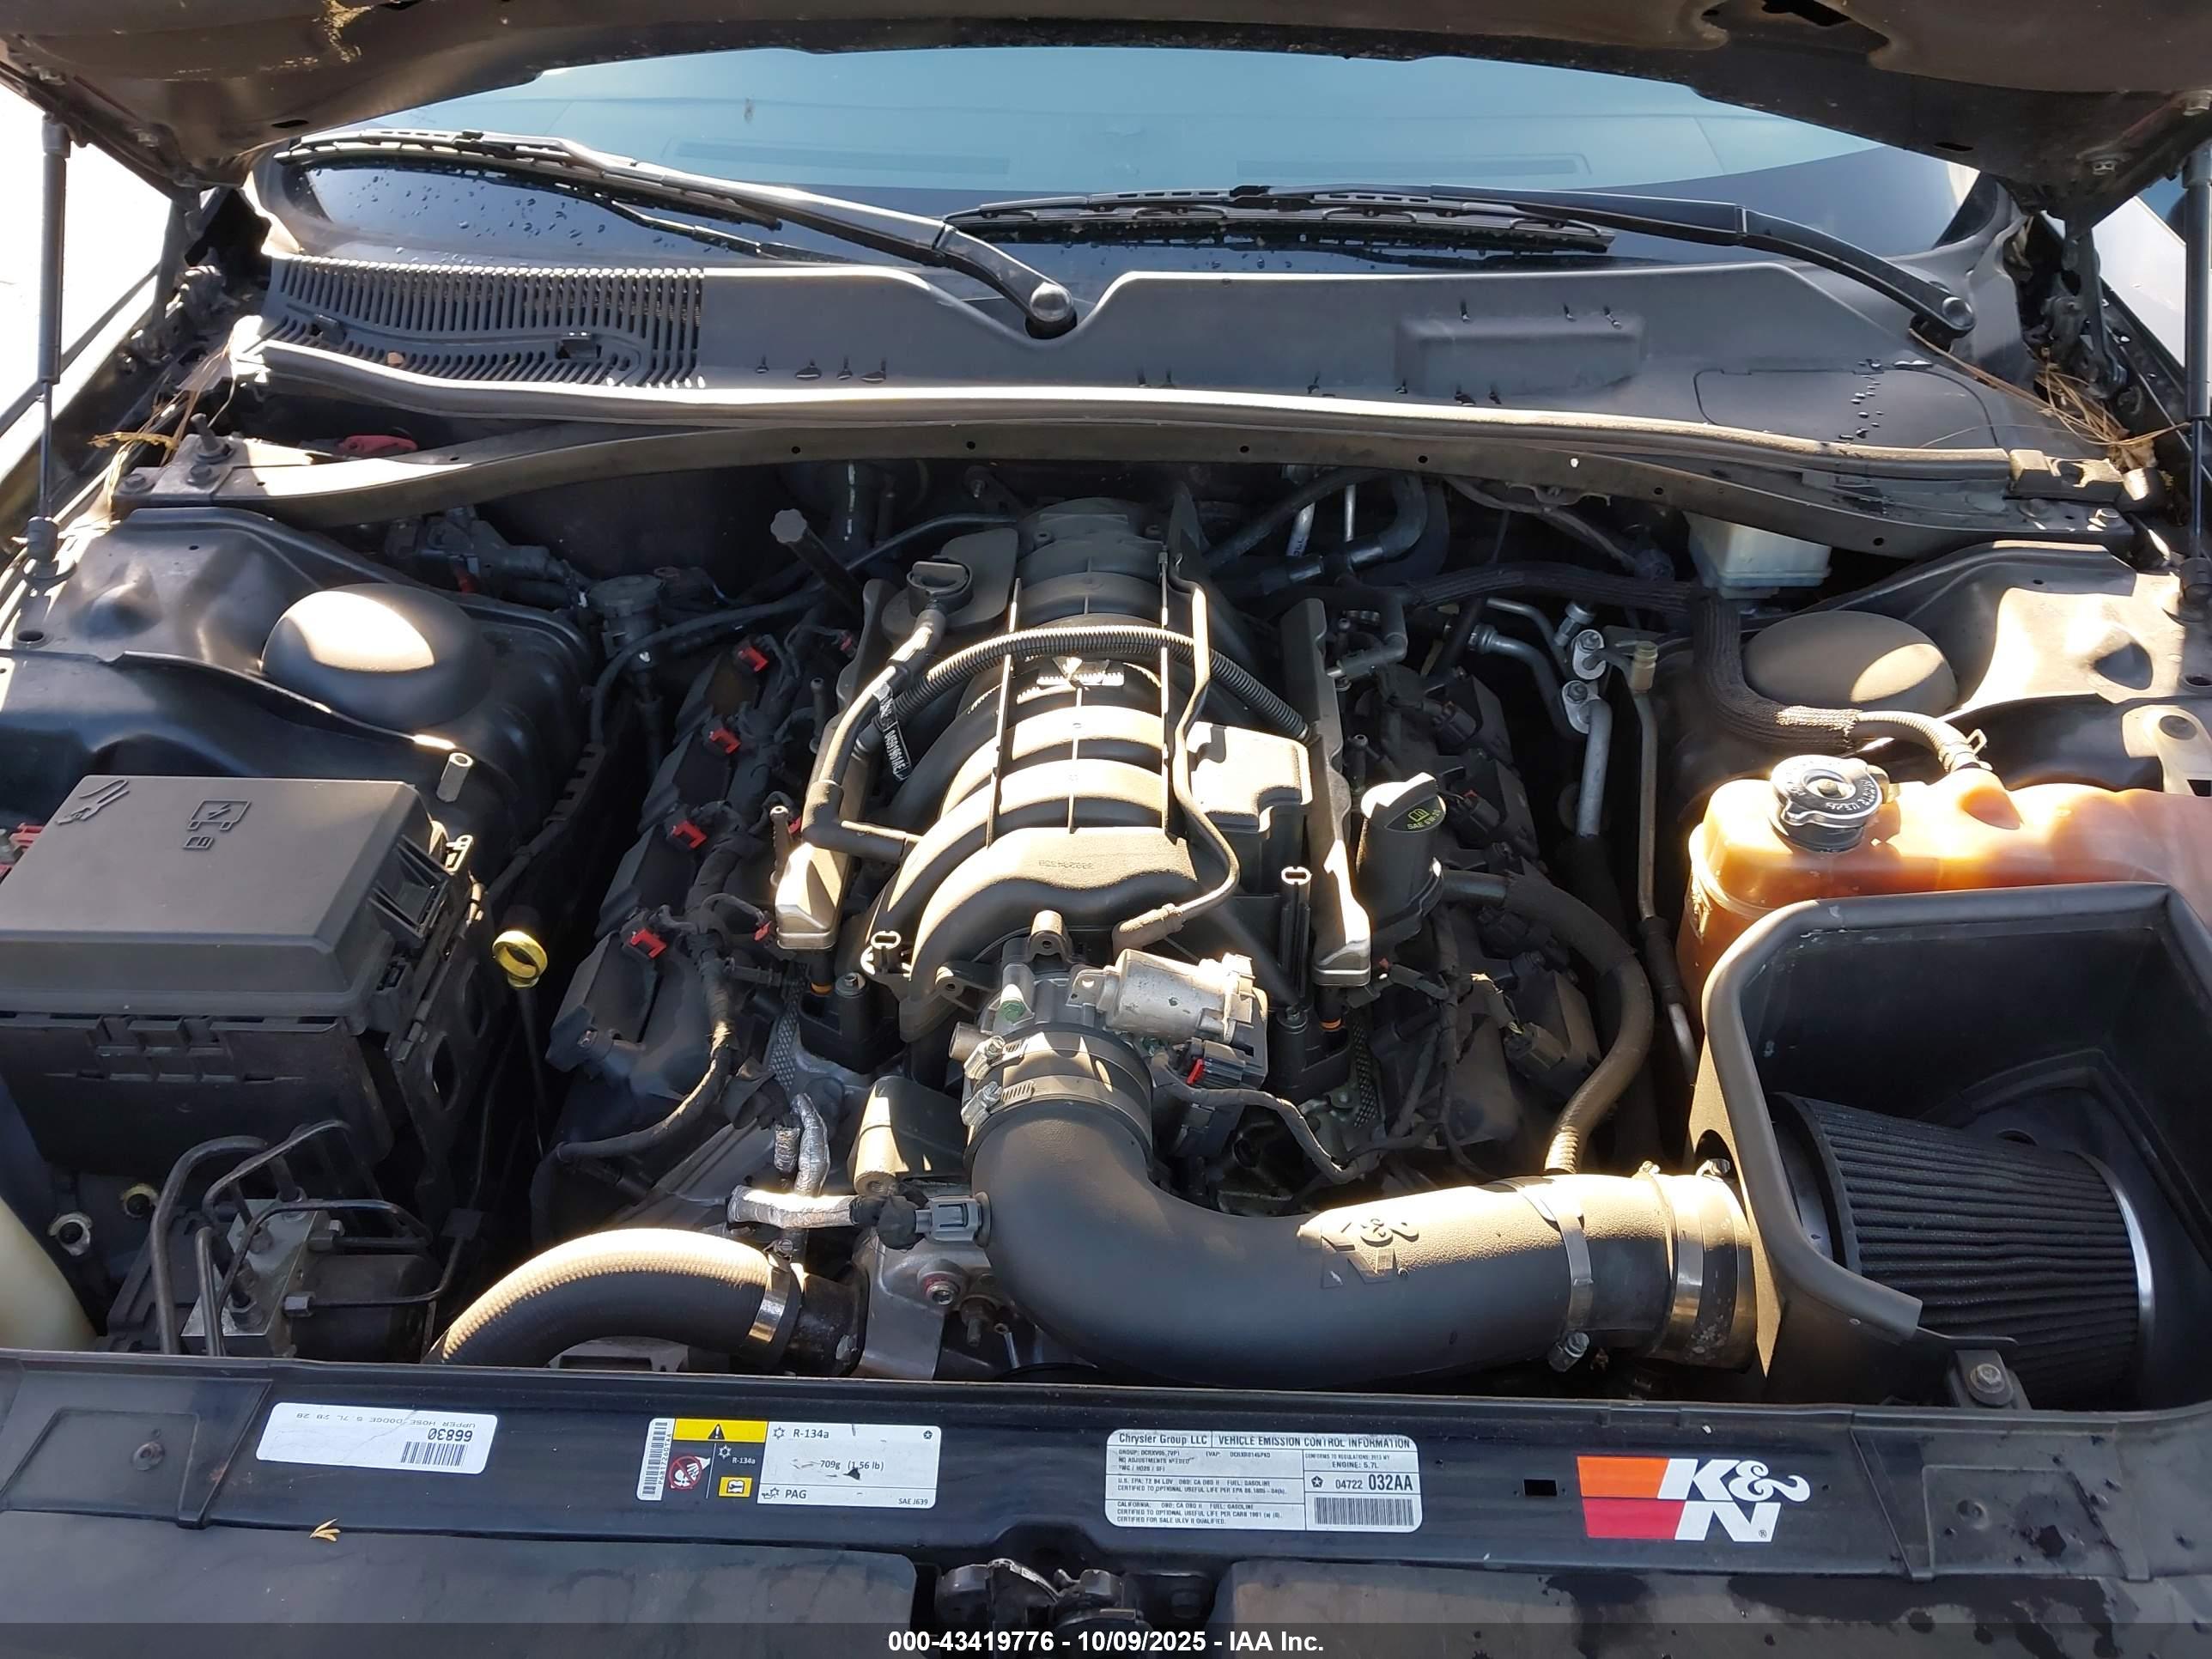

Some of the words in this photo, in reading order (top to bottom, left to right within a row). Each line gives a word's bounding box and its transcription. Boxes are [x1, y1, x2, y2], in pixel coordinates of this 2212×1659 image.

[428, 1428, 473, 1443] 66830
[793, 1429, 830, 1438] R-134a
[1119, 1433, 1157, 1444] Chrysler
[1160, 1434, 1187, 1445] Group
[1190, 1435, 1207, 1444] LLC
[1218, 1436, 1255, 1445] VEHICLE
[1258, 1436, 1301, 1446] EMISSION
[1304, 1437, 1346, 1447] CONTROL
[1348, 1437, 1411, 1449] INFORMATION
[820, 1461, 841, 1470] 709g
[848, 1461, 870, 1470] (156
[872, 1461, 884, 1471] lb)
[1335, 1479, 1363, 1490] 04722
[1368, 1474, 1413, 1491] 032AA
[785, 1489, 807, 1499] PAG
